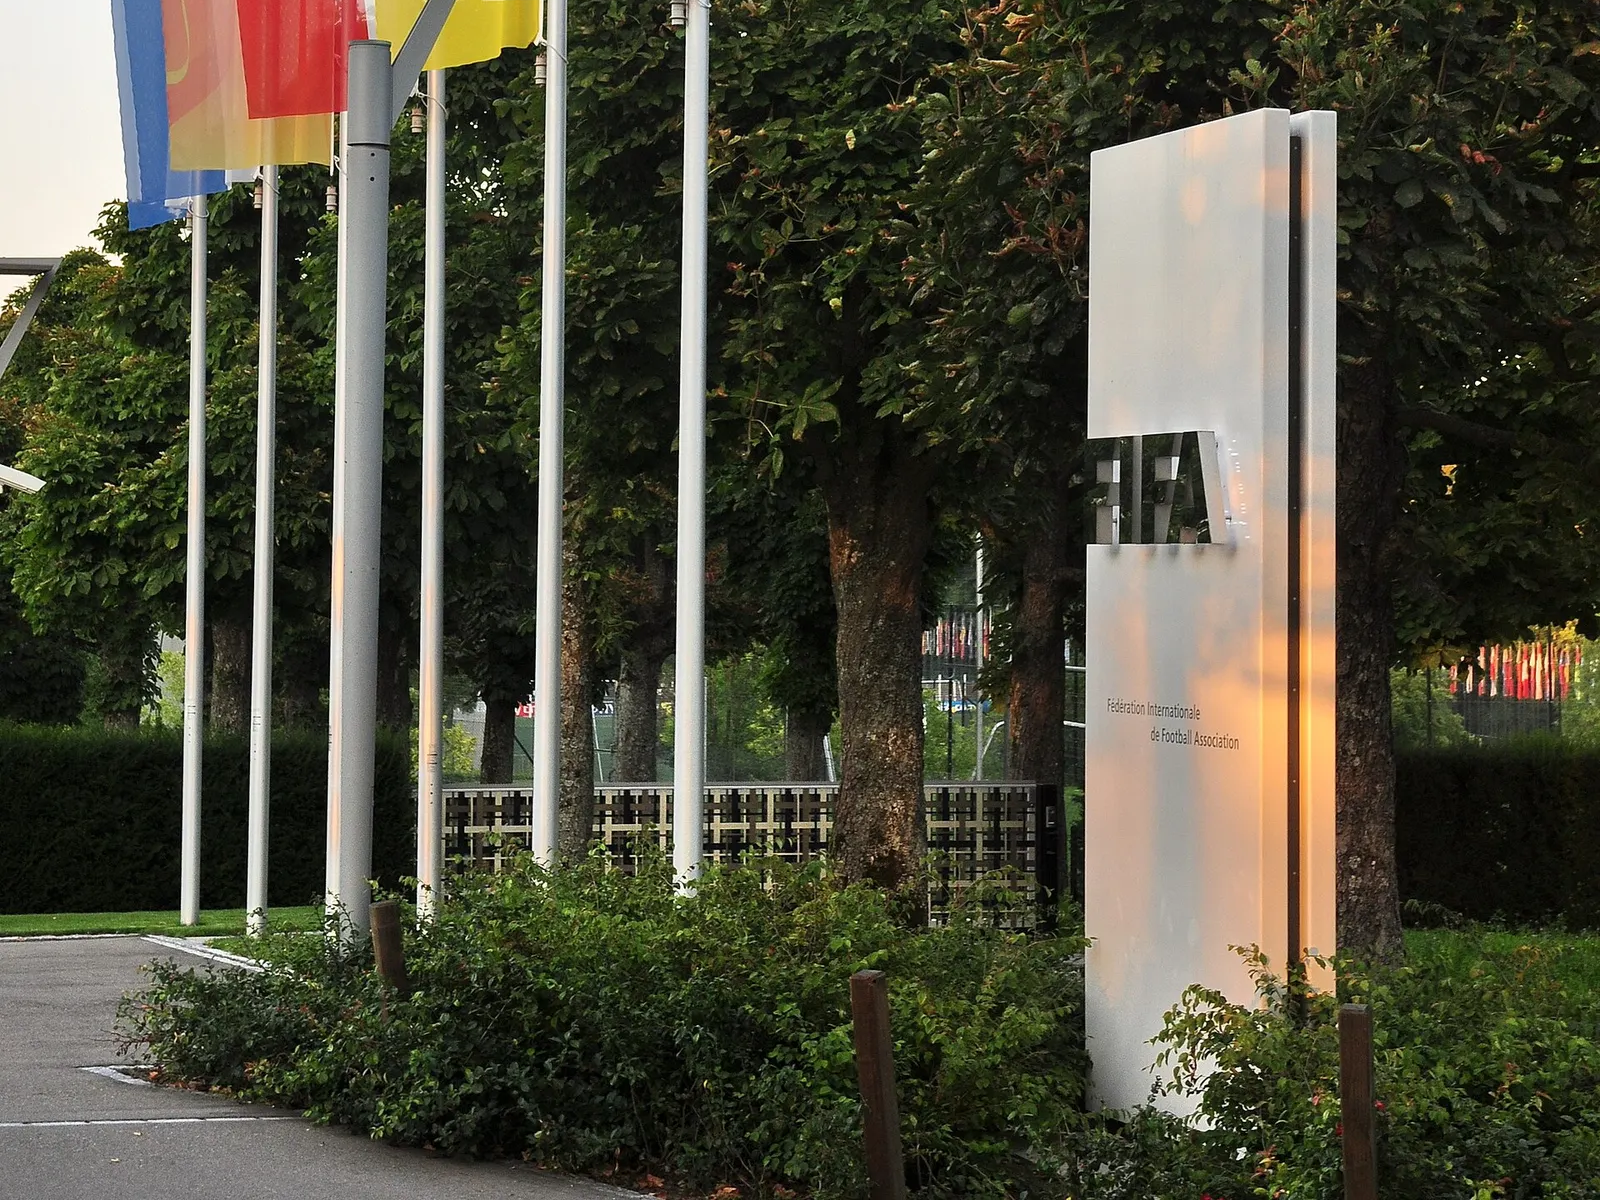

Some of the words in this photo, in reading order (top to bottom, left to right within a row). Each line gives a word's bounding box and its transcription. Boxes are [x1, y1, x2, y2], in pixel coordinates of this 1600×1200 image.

[1107, 698, 1145, 716] Fédération
[1147, 701, 1201, 720] Internationale
[1150, 726, 1160, 742] de
[1161, 728, 1192, 745] Football
[1193, 731, 1240, 750] Association
